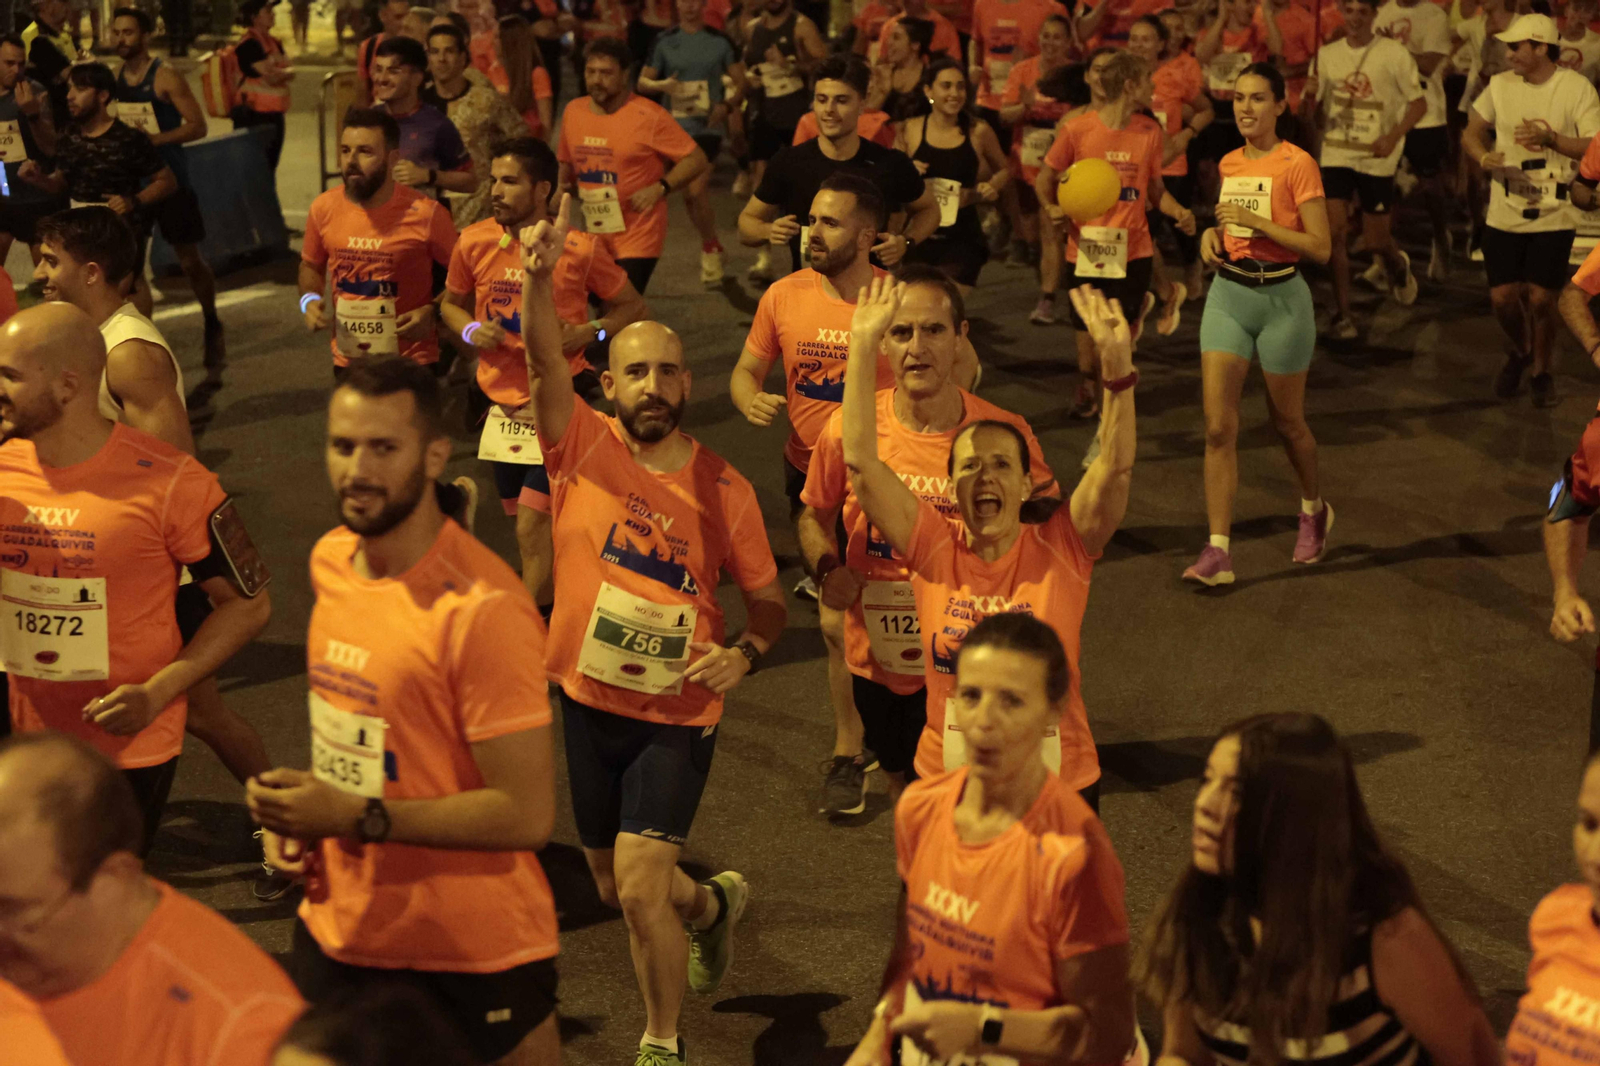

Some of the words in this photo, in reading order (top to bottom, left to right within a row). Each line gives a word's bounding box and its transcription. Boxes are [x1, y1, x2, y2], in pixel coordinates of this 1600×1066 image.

[347, 236, 383, 250] XXXV
[1087, 245, 1117, 256] 17003
[343, 321, 384, 334] 14658
[797, 341, 831, 350] CARRERA
[799, 362, 818, 371] KH7
[24, 506, 80, 526] XXXV
[44, 528, 96, 539] NOCTURNA
[624, 518, 647, 535] KH7
[3, 534, 95, 551] GUADALQUIVIR
[15, 610, 84, 637] 18272
[943, 625, 966, 638] KH7
[620, 627, 663, 656] 756
[924, 880, 980, 925] XXXV
